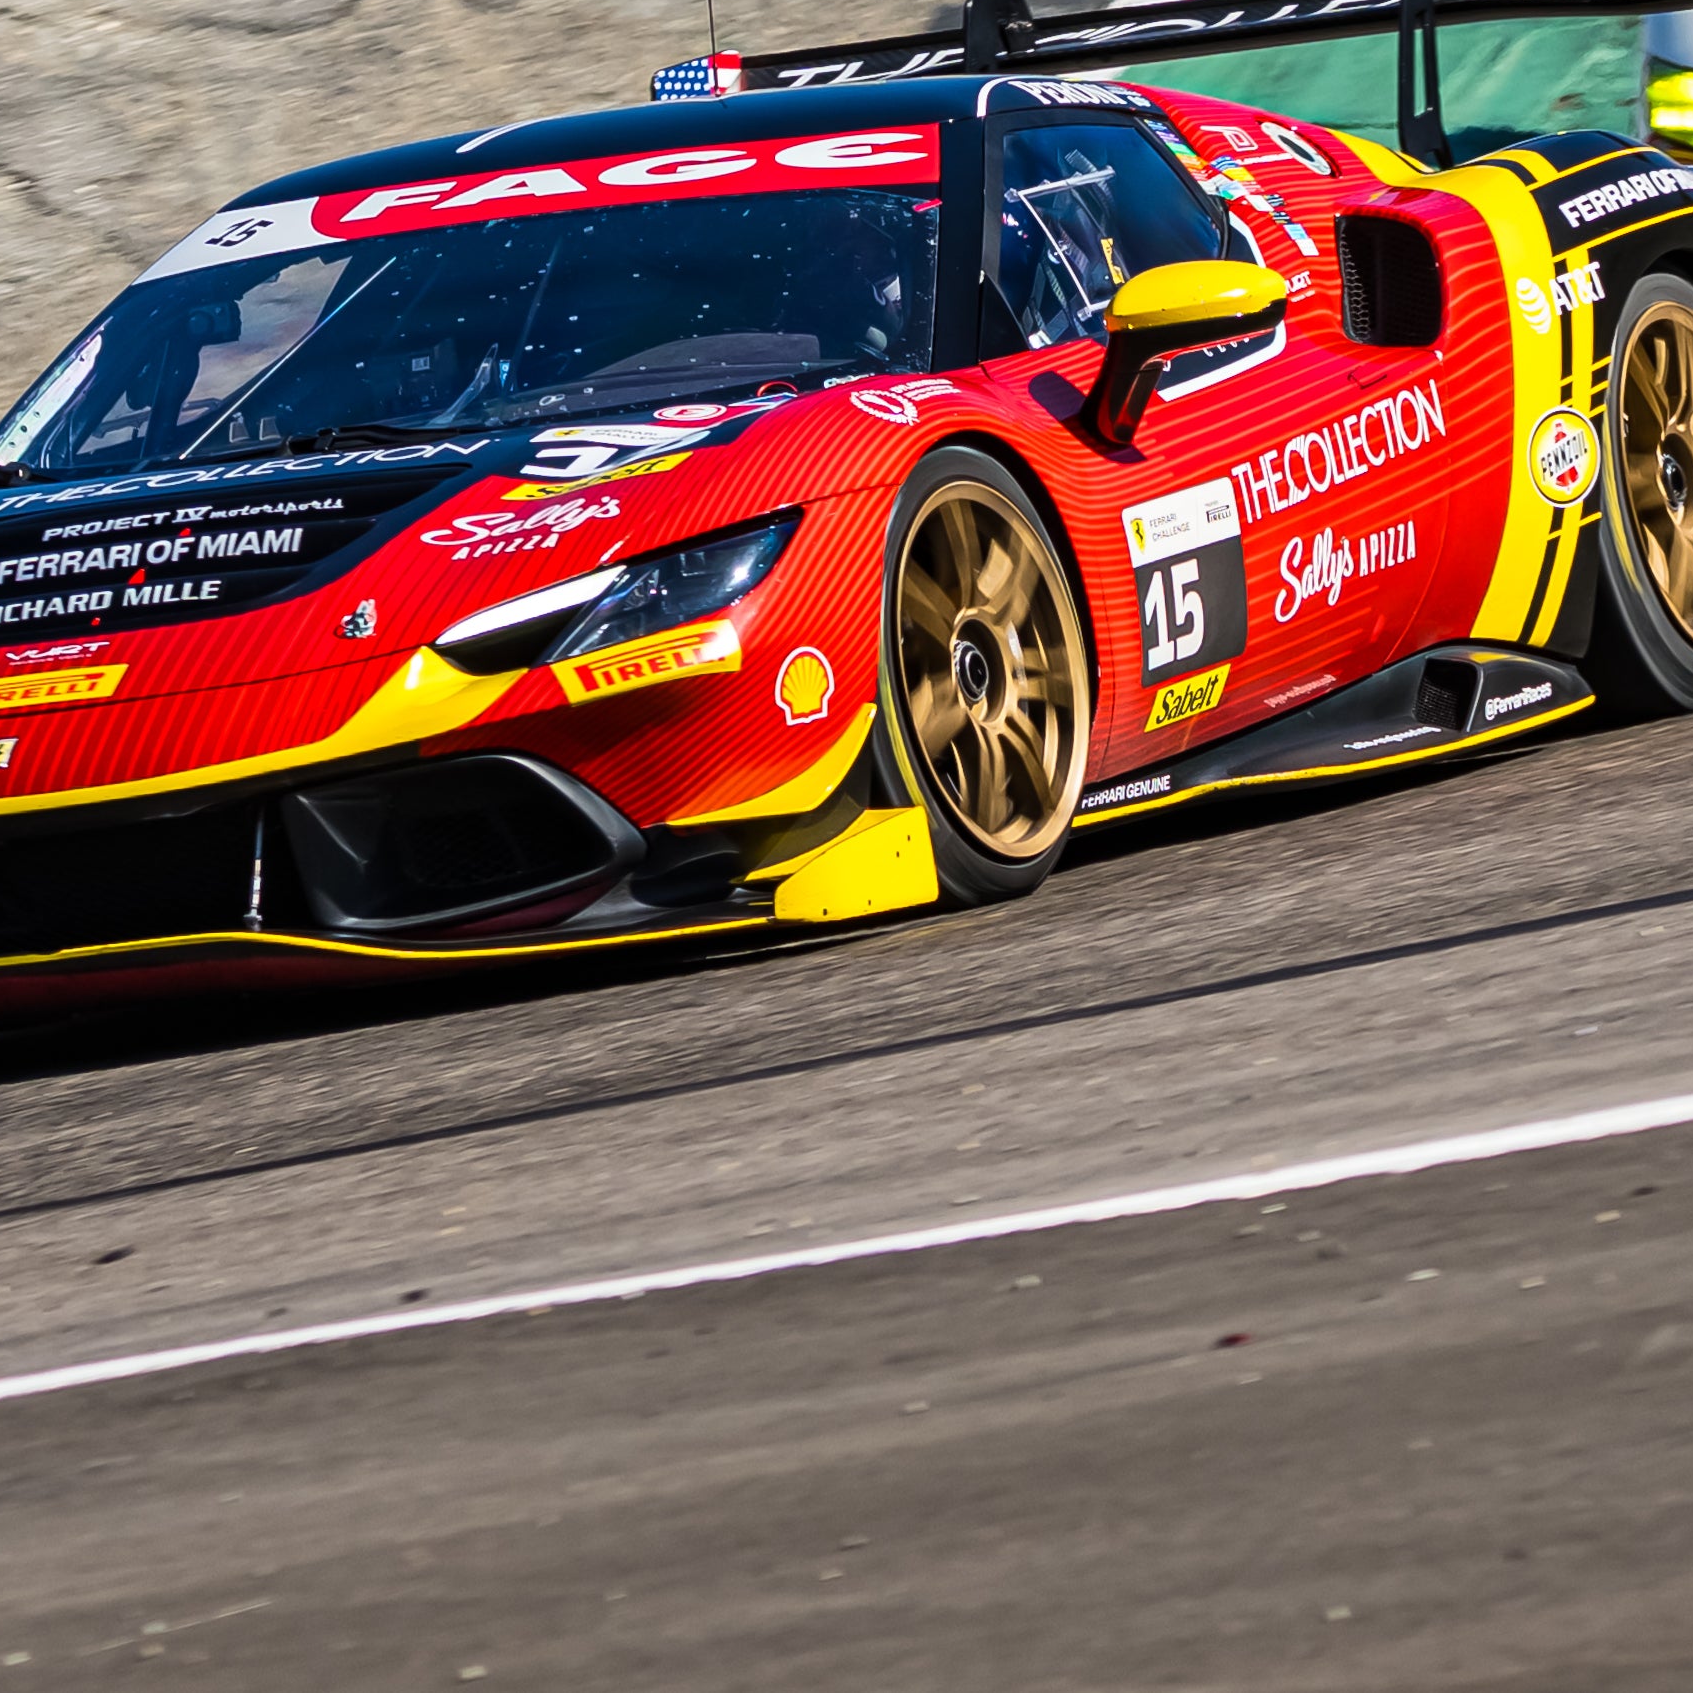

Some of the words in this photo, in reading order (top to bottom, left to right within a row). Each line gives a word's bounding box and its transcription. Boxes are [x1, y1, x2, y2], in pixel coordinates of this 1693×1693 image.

[339, 132, 929, 222] FAGE
[1558, 172, 1660, 229] FERRARI
[204, 217, 275, 248] 15
[1549, 261, 1606, 316] AT&T
[1541, 429, 1588, 482] PENNZOIL
[42, 514, 166, 543] PROJECT
[172, 507, 213, 525] IV
[209, 497, 345, 521] motorsports
[420, 495, 621, 546] Sally's
[1206, 504, 1232, 524] PIRELLI
[145, 537, 194, 567] OF
[198, 528, 304, 561] MIAMI
[452, 533, 559, 561] APIZZA
[1274, 527, 1355, 623] Sally's
[1359, 519, 1417, 578] APIZZA
[122, 580, 223, 608] MILLE
[1144, 558, 1205, 672] 15
[1156, 673, 1220, 726] Sabelt
[1081, 785, 1126, 809] FERRARI
[1126, 774, 1171, 799] GENUINE
